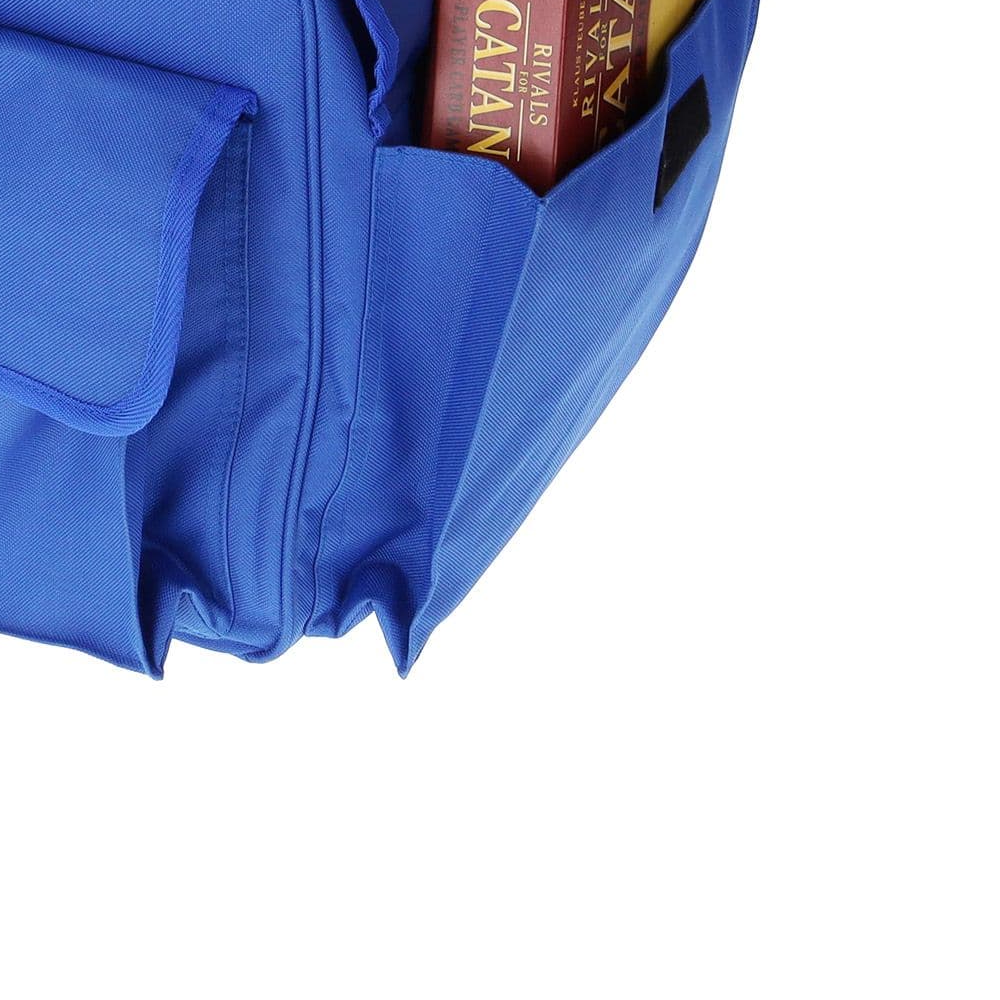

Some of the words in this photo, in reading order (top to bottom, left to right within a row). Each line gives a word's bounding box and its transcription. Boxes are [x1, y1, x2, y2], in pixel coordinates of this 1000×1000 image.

[599, 21, 609, 61] FOR
[518, 70, 529, 95] FOR
[530, 42, 553, 128] RIVALS
[571, 54, 582, 108] KLAUS
[446, 116, 465, 150] GAM
